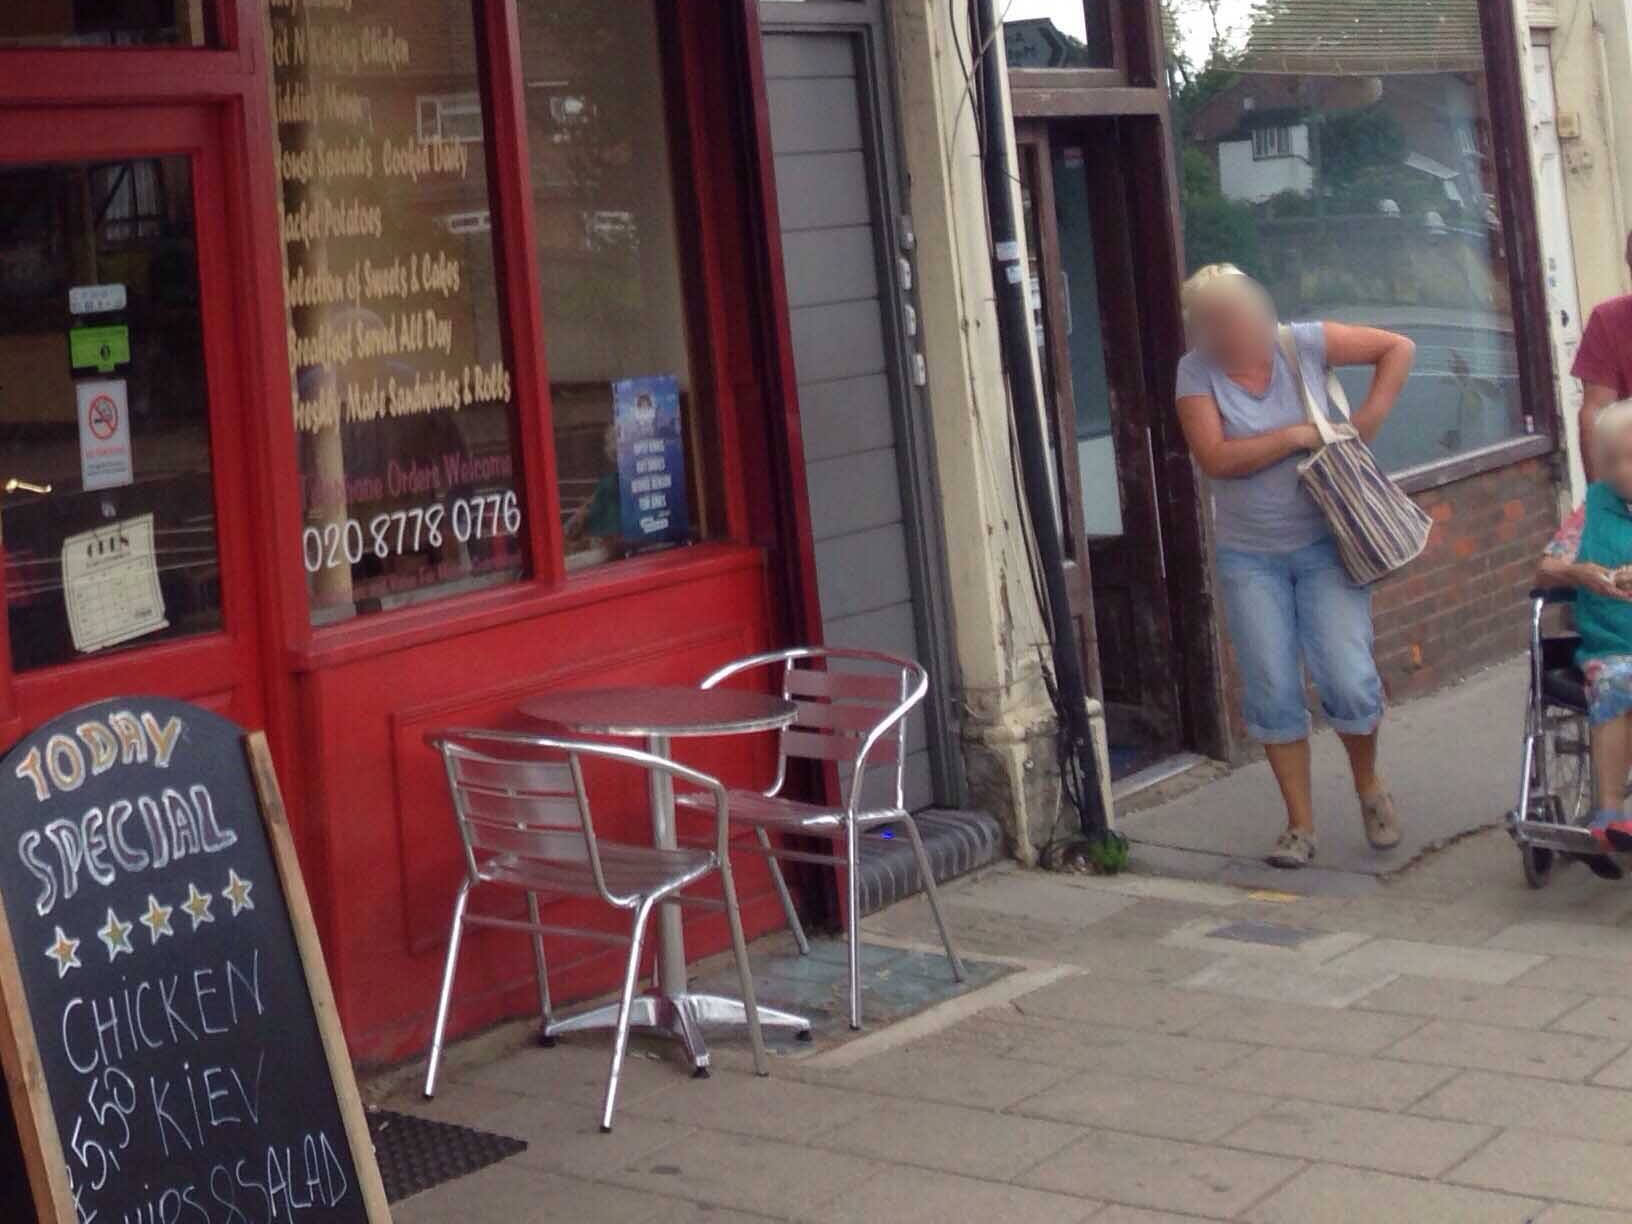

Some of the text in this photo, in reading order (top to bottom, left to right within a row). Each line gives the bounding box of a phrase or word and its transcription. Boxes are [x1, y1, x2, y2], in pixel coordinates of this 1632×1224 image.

[301, 489, 522, 573] 020 8778 0776
[15, 710, 182, 803] TODAY
[18, 784, 239, 918] SPECIAL
[61, 947, 266, 1075] CHICKEN
